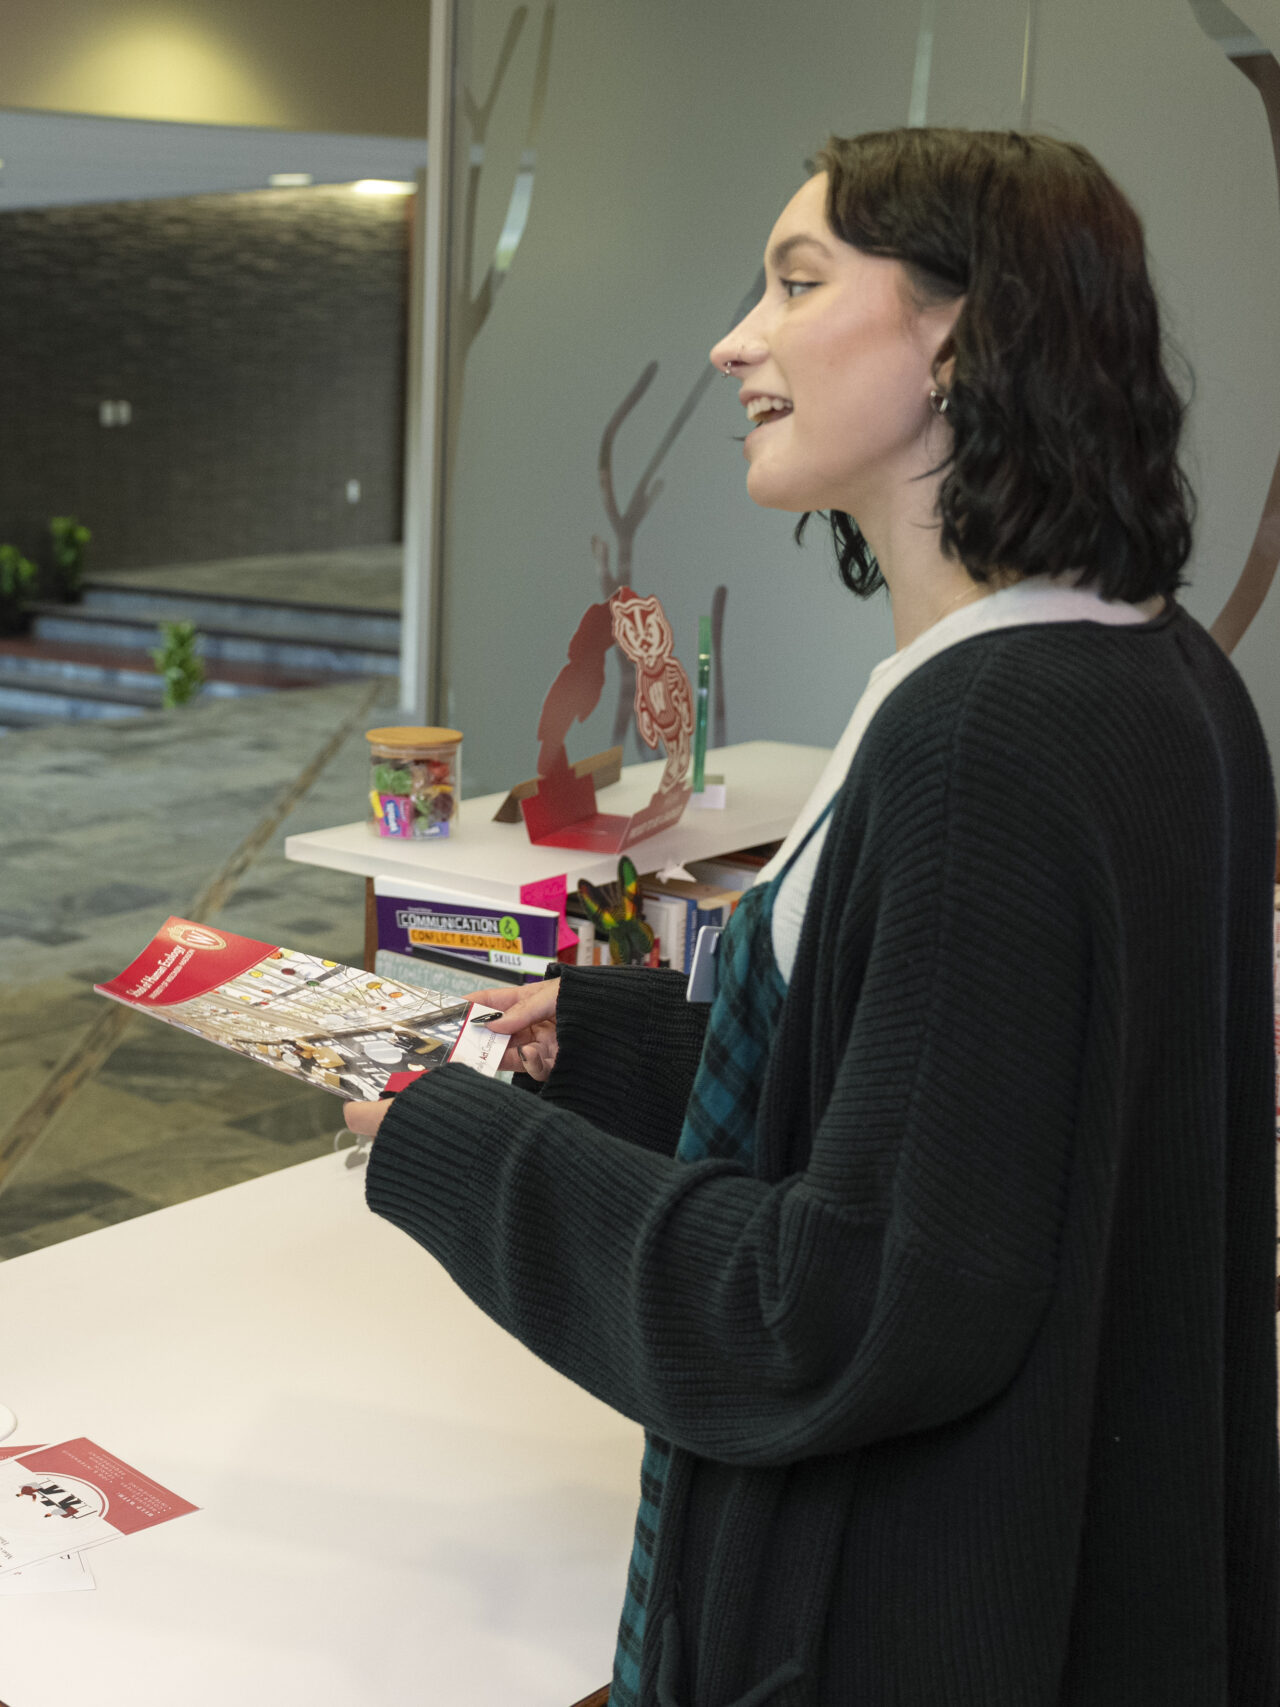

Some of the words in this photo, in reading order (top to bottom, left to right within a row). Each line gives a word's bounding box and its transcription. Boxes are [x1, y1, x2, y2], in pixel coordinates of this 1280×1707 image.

[400, 912, 499, 933] COMMUNICATION
[504, 918, 516, 937] &
[409, 928, 457, 945] CONFLICT
[459, 934, 520, 951] RESOLUTION
[493, 952, 523, 967] SKILLS
